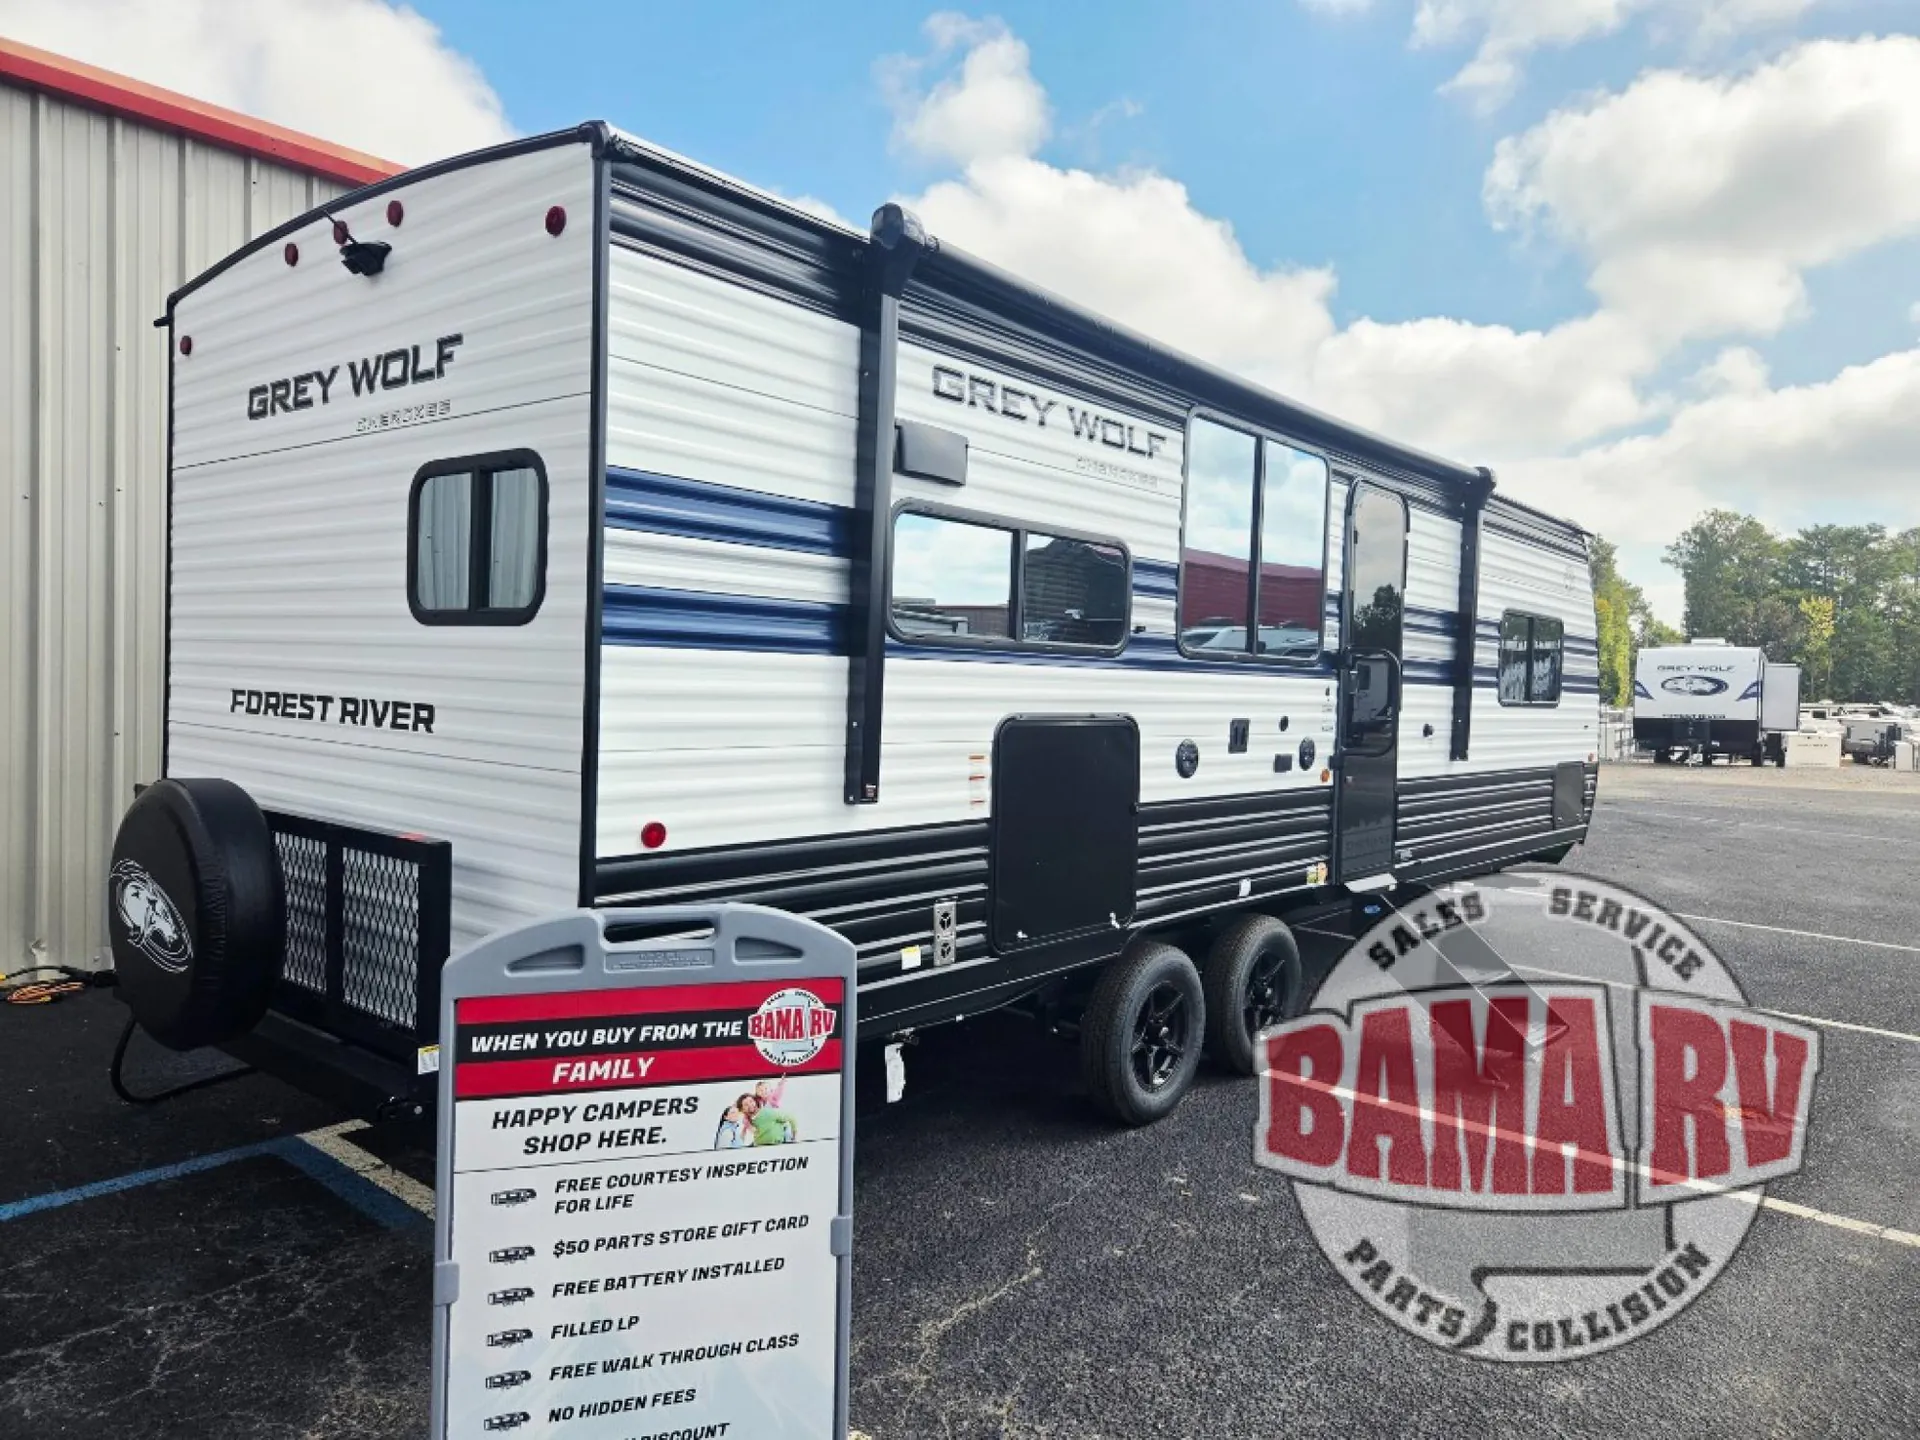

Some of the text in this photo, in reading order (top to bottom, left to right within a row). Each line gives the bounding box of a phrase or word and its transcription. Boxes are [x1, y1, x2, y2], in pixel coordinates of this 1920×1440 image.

[247, 333, 463, 420] GREY WOLF
[932, 364, 1167, 459] GREY WOLF
[230, 688, 435, 734] FOREST RIVER
[471, 1021, 743, 1053] WHEN YOU BUY FROM THE
[750, 1007, 834, 1040] BAMA RV
[552, 1057, 655, 1084] FAMILY
[492, 1096, 699, 1130] HAPPY CAMPERS
[523, 1126, 668, 1156] SHOP HERE.
[554, 1156, 809, 1194] FREE COURTESY INSPECTION
[554, 1194, 635, 1215] FOR LIFE
[552, 1214, 809, 1258] $50 PARTS STORE GIFT CARD
[552, 1257, 785, 1298] FREE BATTERY INSTALLED
[550, 1315, 640, 1339] FILLED LP
[549, 1333, 799, 1381] FREE WALK THROUGH CLASS
[548, 1388, 697, 1423] NO HIDDEN FEES
